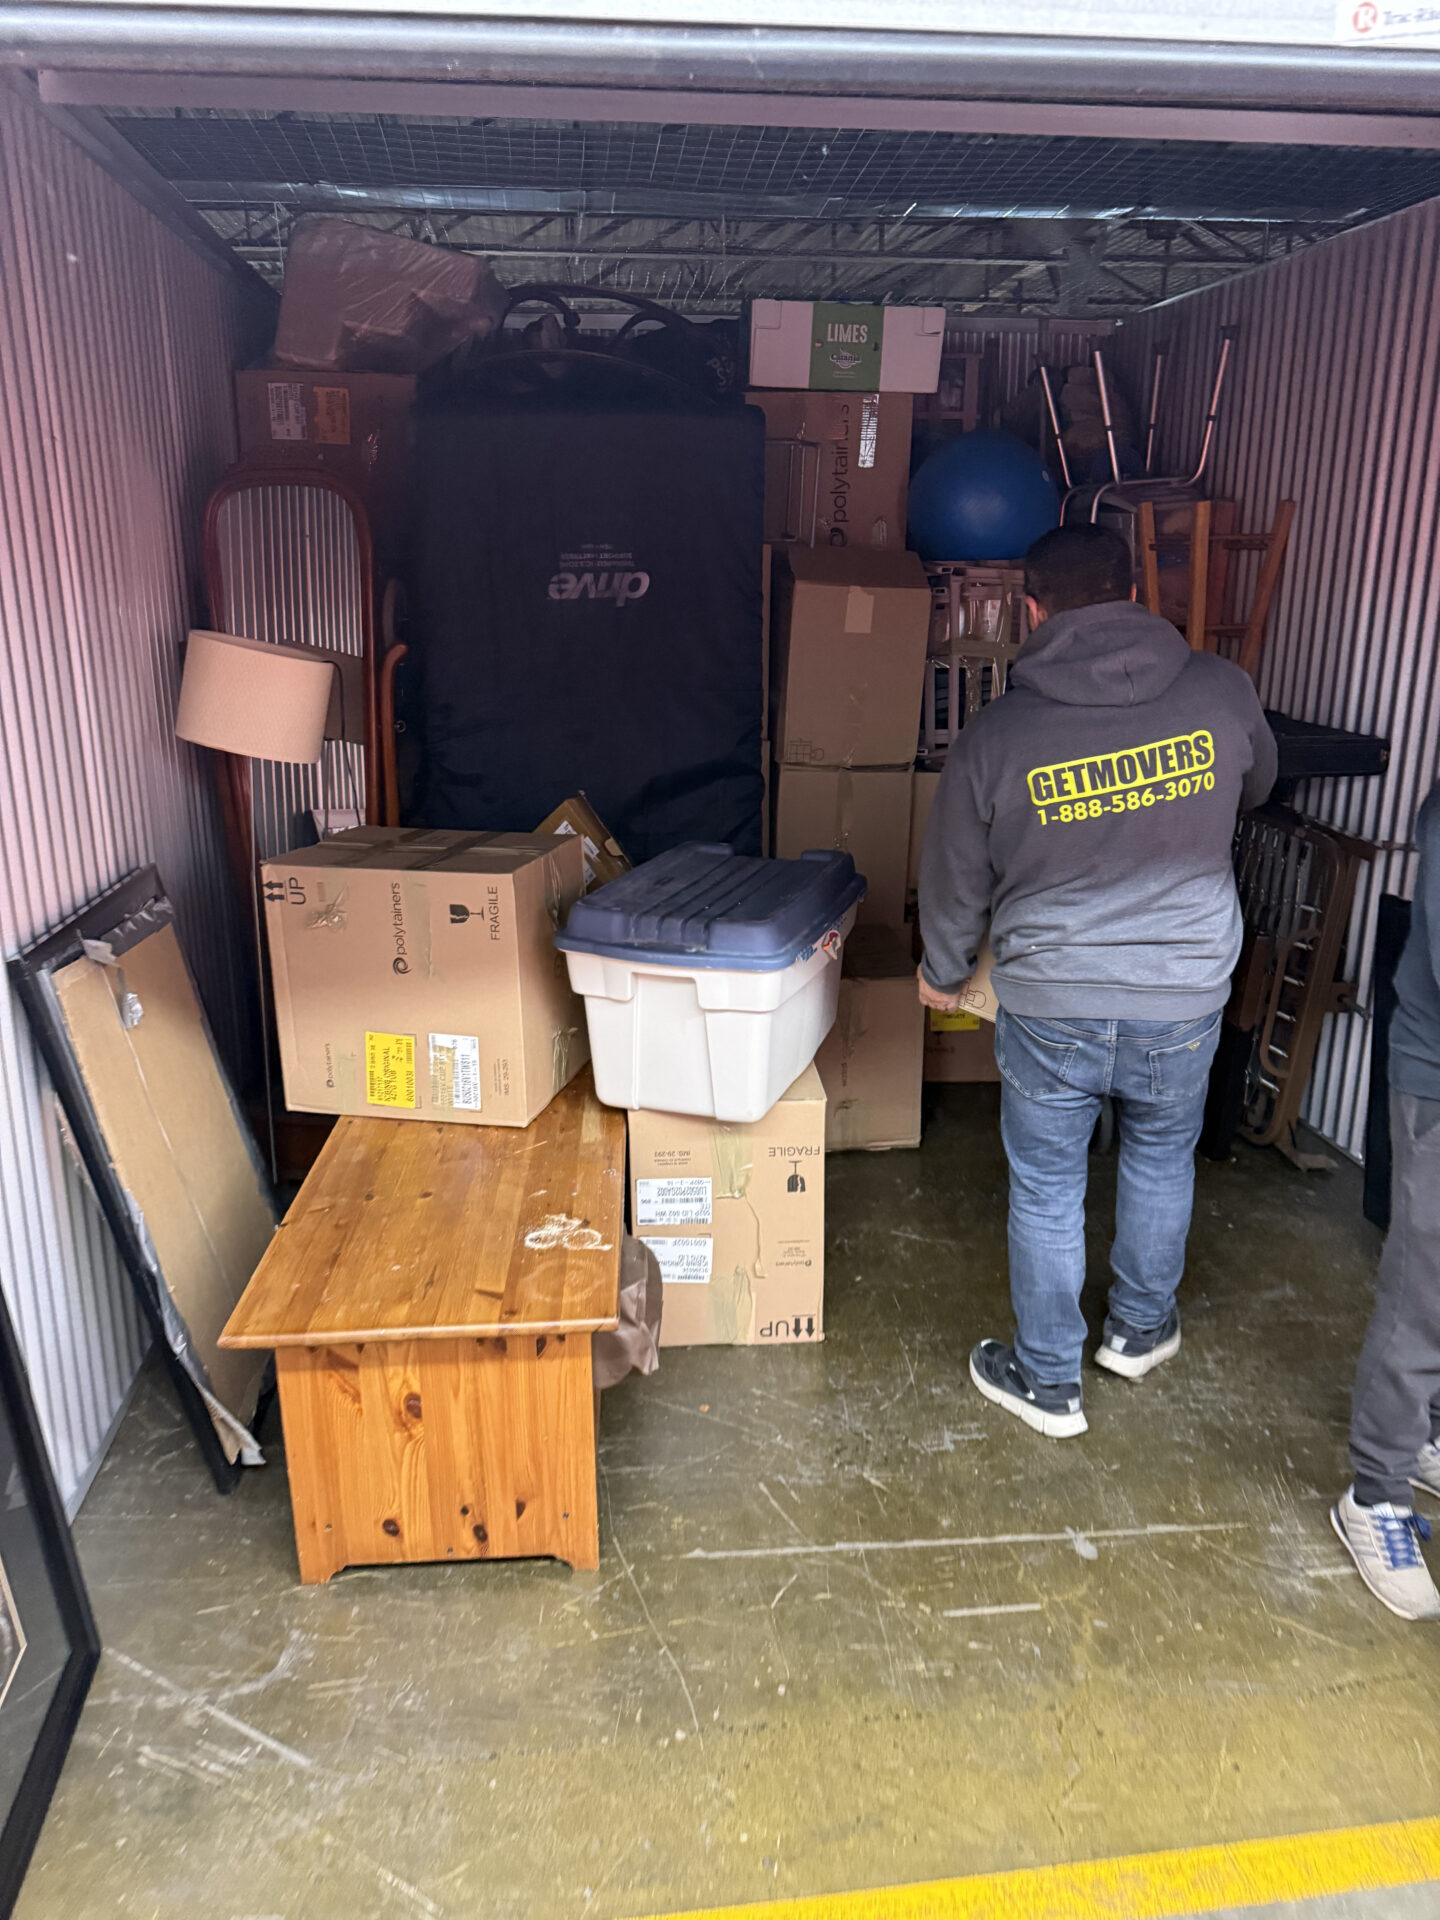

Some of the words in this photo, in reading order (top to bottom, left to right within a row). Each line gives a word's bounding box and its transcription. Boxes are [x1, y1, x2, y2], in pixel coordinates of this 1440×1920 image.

[826, 323, 868, 344] LIMES
[548, 571, 650, 607] drive
[1029, 731, 1214, 804] GETMOVERS
[1037, 771, 1216, 825] 1-888-586-3070
[290, 876, 307, 906] UP
[391, 882, 408, 957] polytainers
[490, 885, 501, 942] FRAGILE
[768, 1146, 820, 1157] FRAGILE
[759, 1320, 790, 1338] UP
